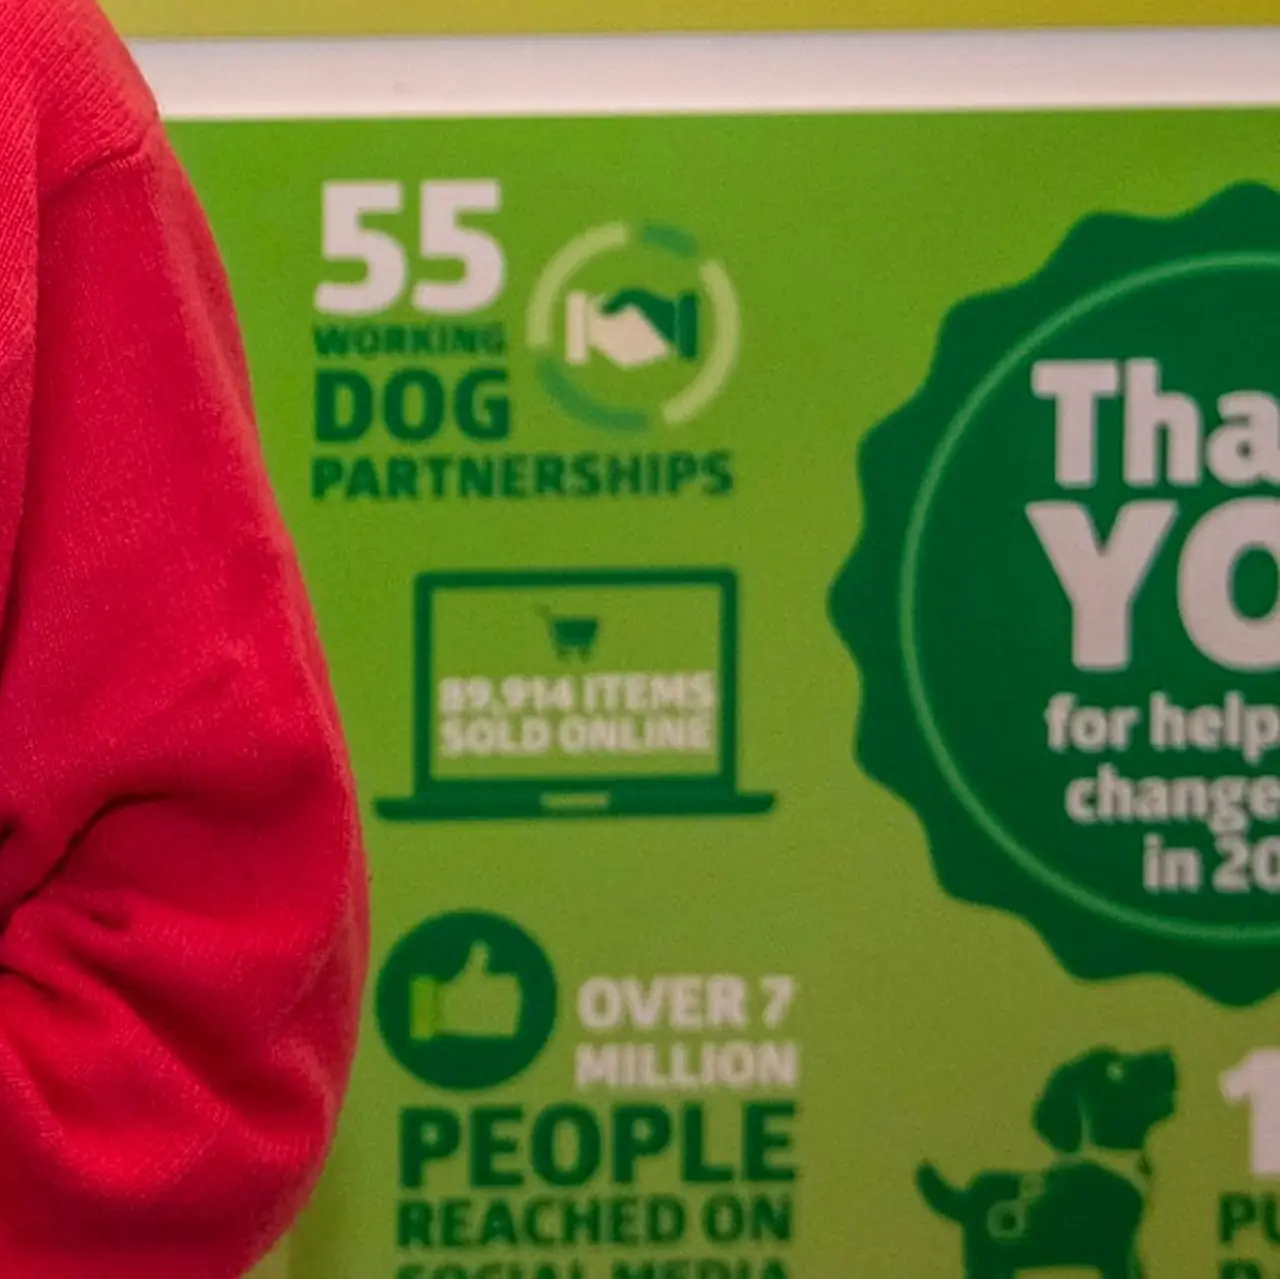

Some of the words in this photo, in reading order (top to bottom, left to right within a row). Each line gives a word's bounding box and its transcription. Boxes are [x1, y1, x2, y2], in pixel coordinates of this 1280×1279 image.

[314, 179, 506, 315] 55
[313, 322, 507, 358] WORKING
[314, 367, 511, 443] DOG
[1031, 358, 1280, 487] Tha
[311, 450, 734, 501] PARTNERSHIPS
[1025, 497, 1280, 671] YO
[583, 671, 716, 711] ITEMS
[440, 717, 552, 757] SOLD
[557, 715, 713, 755] ONLINE
[1044, 692, 1139, 752] for
[1150, 690, 1280, 764] help
[1143, 832, 1202, 892] in
[1212, 835, 1280, 893] 20
[577, 974, 747, 1030] OVER
[760, 975, 797, 1029] 7
[575, 1040, 799, 1089] MILLION
[398, 1100, 798, 1191] PEOPLE
[396, 1195, 688, 1251] REACHED
[702, 1193, 794, 1245] ON
